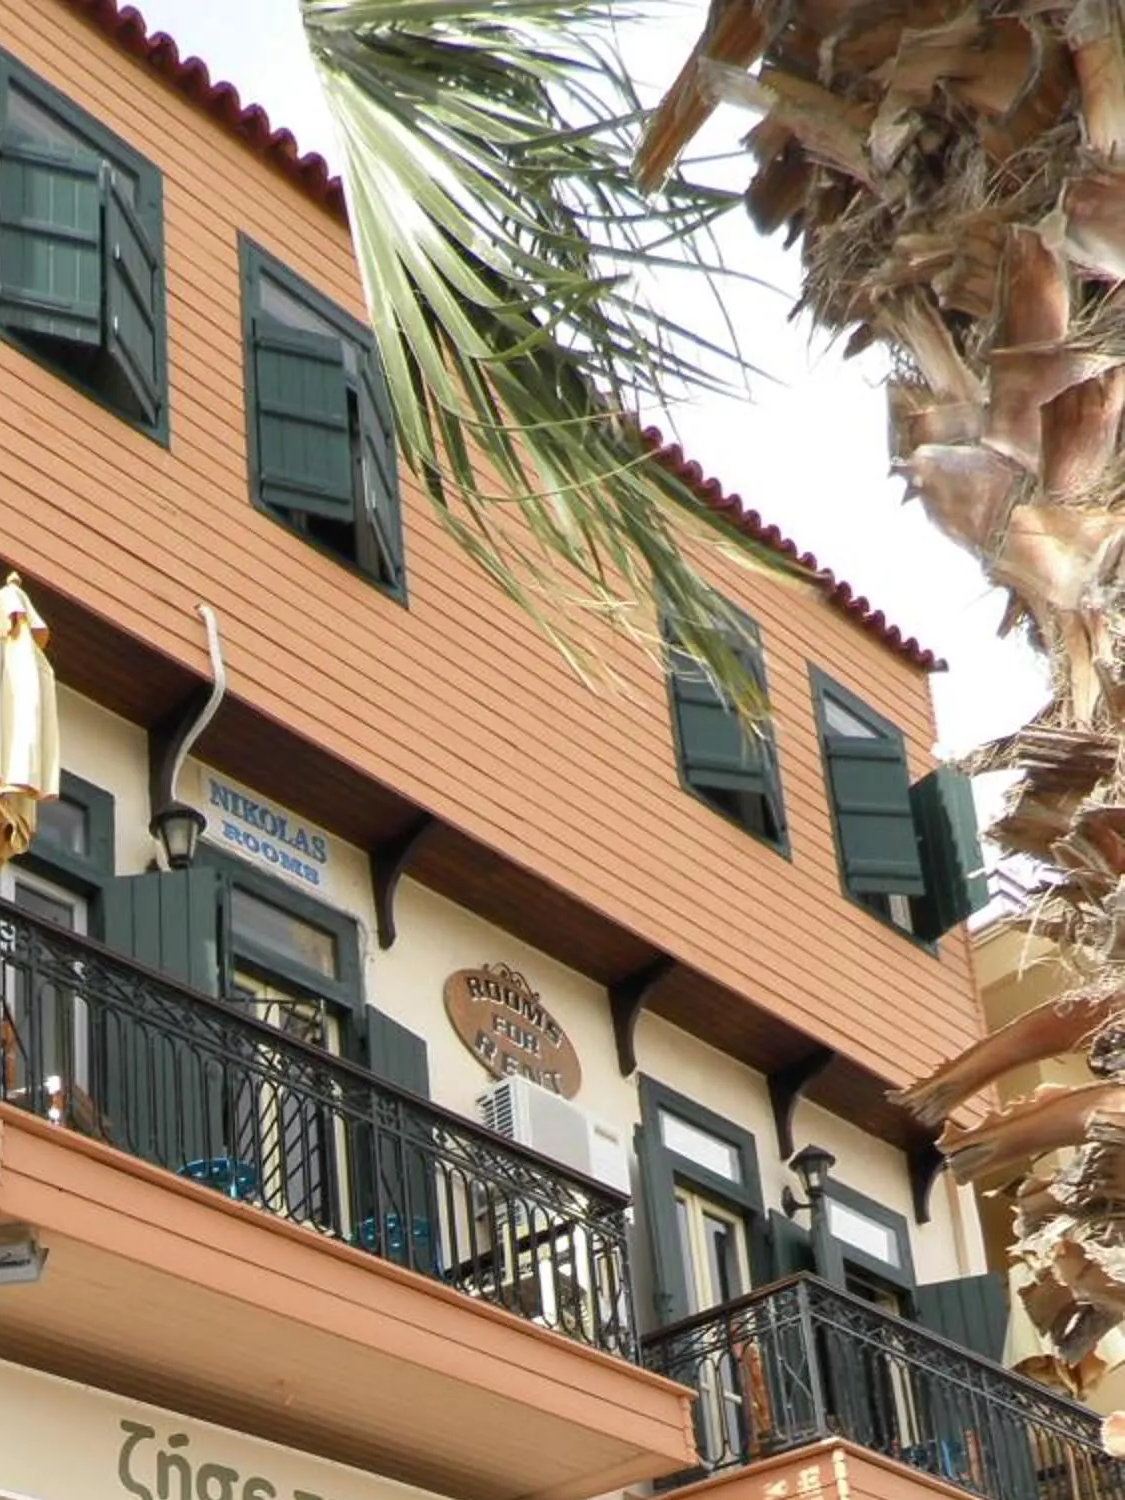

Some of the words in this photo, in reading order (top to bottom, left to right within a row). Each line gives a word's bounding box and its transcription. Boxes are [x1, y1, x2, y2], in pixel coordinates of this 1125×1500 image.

[209, 778, 327, 864] NIKOLAS
[222, 820, 320, 885] ROOMS
[466, 976, 564, 1049] ROOMS
[491, 1012, 542, 1058] FOR
